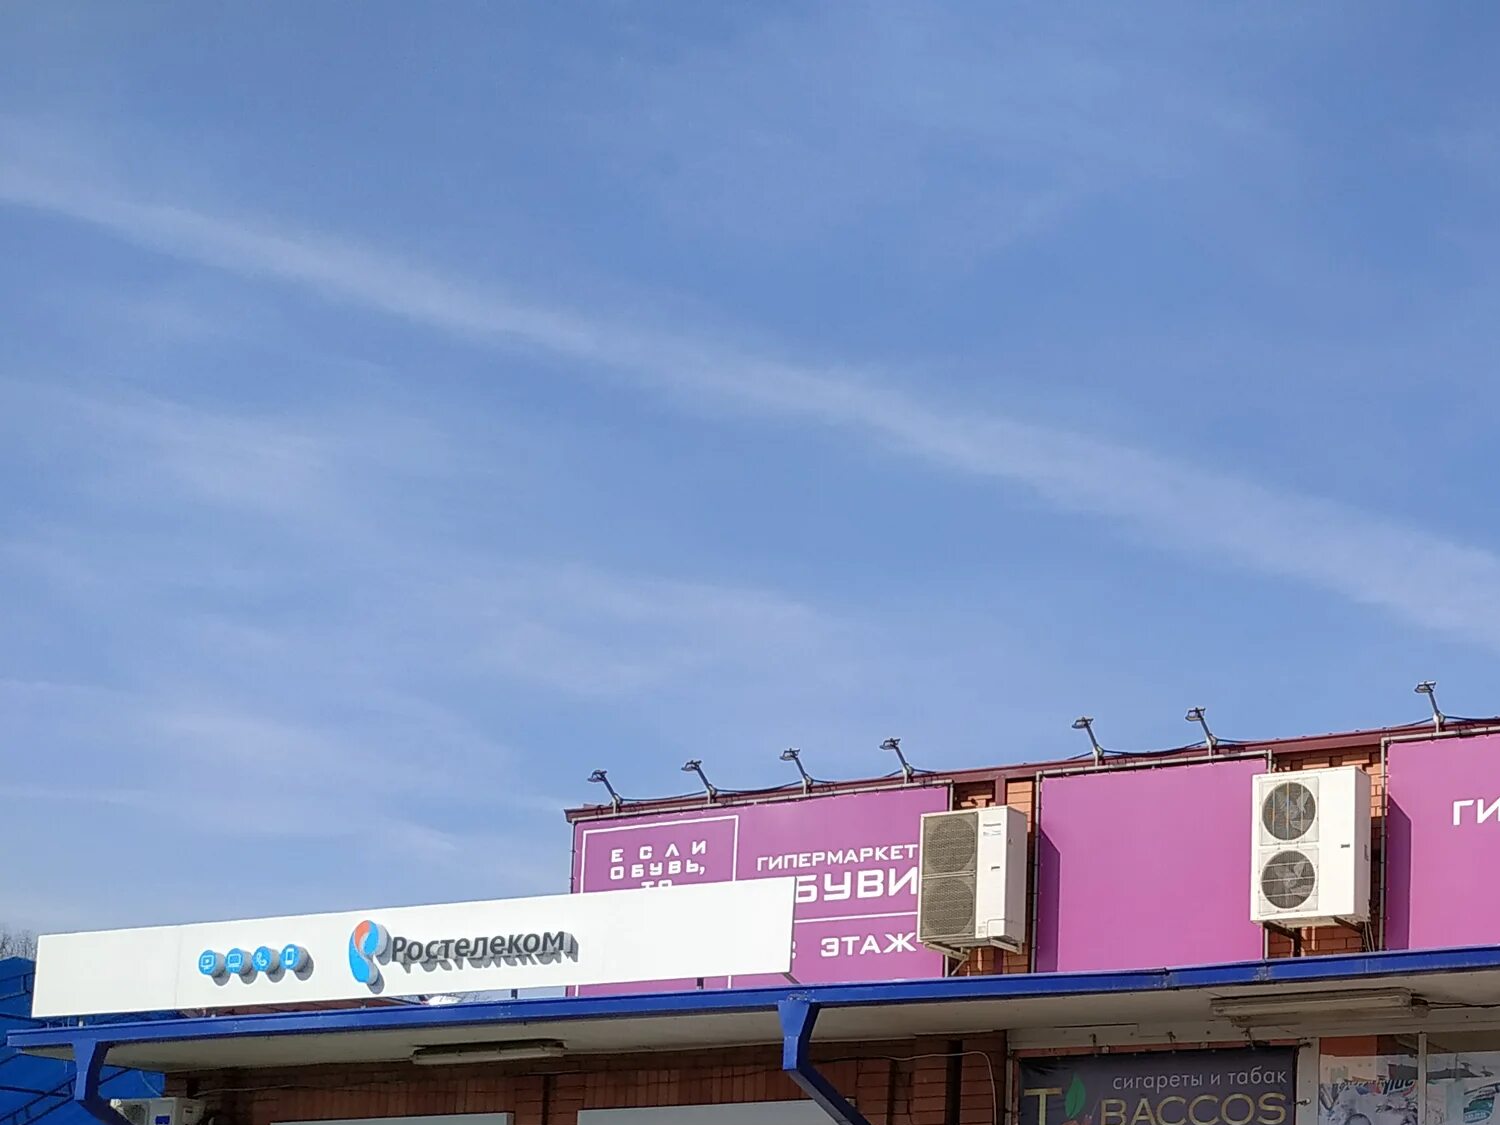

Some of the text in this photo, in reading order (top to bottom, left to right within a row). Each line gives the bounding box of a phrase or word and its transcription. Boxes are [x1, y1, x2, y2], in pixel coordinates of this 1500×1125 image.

[611, 840, 707, 863] ЕСЛИ
[756, 844, 918, 872] ГИПЕРМАРКЕТ
[610, 859, 706, 880] ОБУВЬ,
[795, 866, 918, 904] БУВИ
[391, 931, 566, 963] Ростелеком
[820, 932, 917, 958] ЭТАЖ
[1113, 1065, 1287, 1093] сигареты и табак
